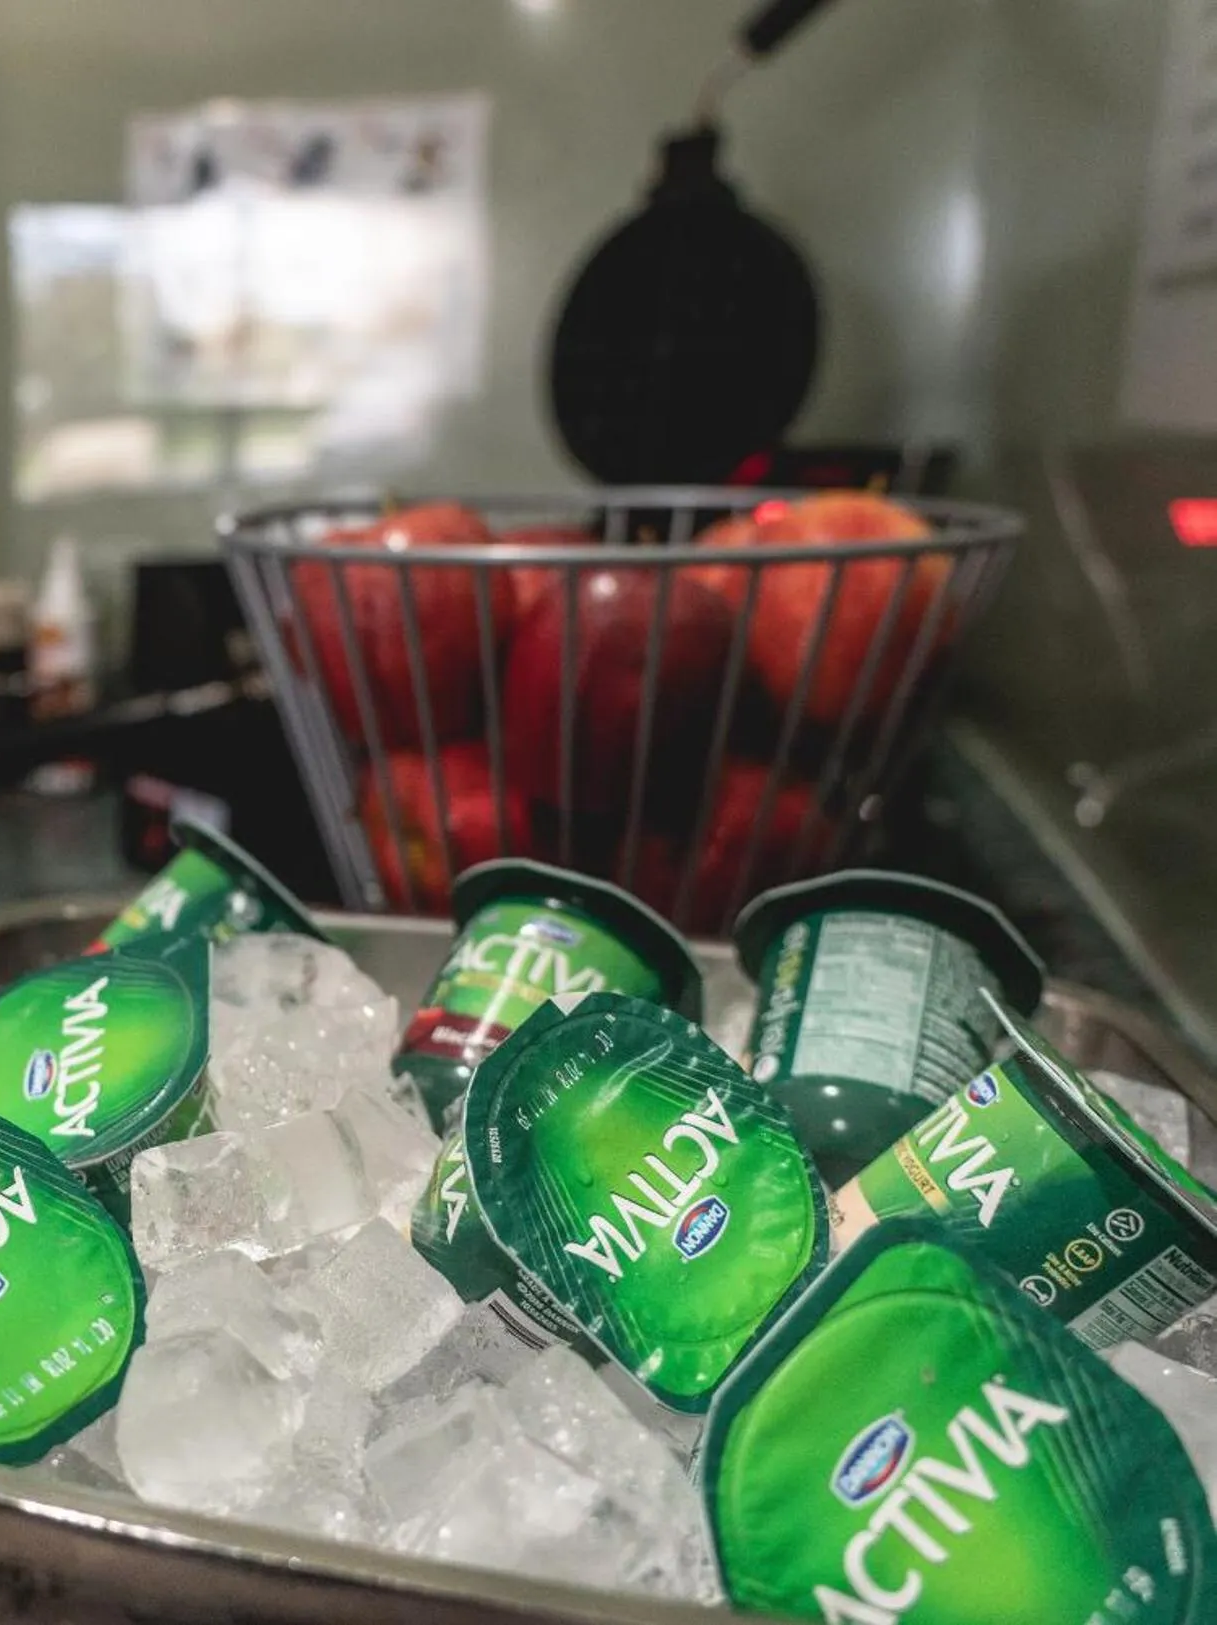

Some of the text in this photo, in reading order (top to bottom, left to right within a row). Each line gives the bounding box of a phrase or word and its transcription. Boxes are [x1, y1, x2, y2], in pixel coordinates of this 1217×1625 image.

[50, 977, 109, 1137] ACTIVIA
[564, 1087, 739, 1278] ACTIVIA
[678, 1200, 728, 1257] DANNON
[812, 1380, 1070, 1625] ACTIVIA
